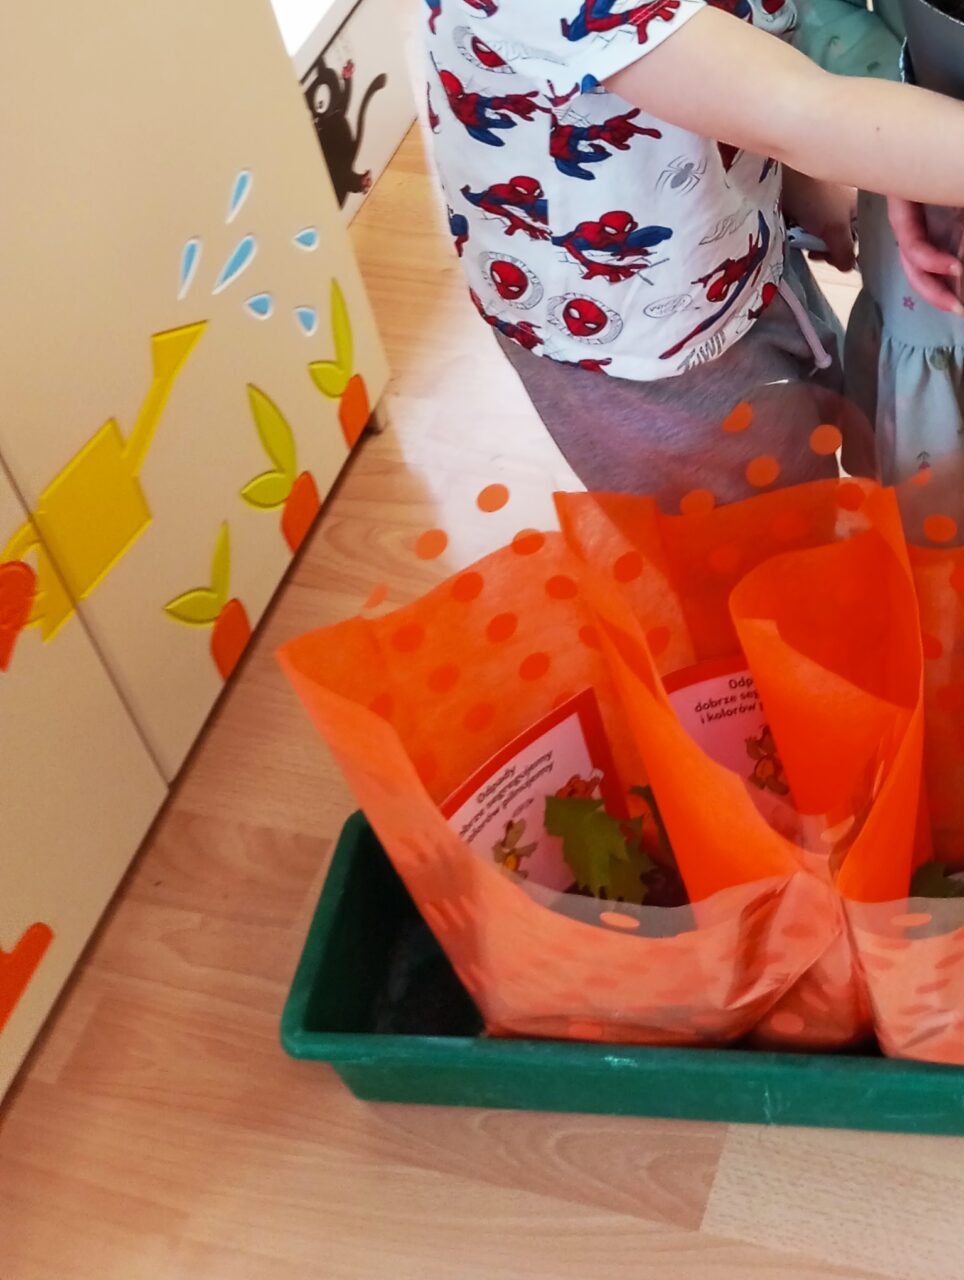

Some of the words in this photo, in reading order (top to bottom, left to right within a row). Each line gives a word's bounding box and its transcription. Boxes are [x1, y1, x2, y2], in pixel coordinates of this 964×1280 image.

[728, 676, 754, 690] Odp
[694, 694, 738, 713] dobrze
[705, 701, 757, 723] kolorów
